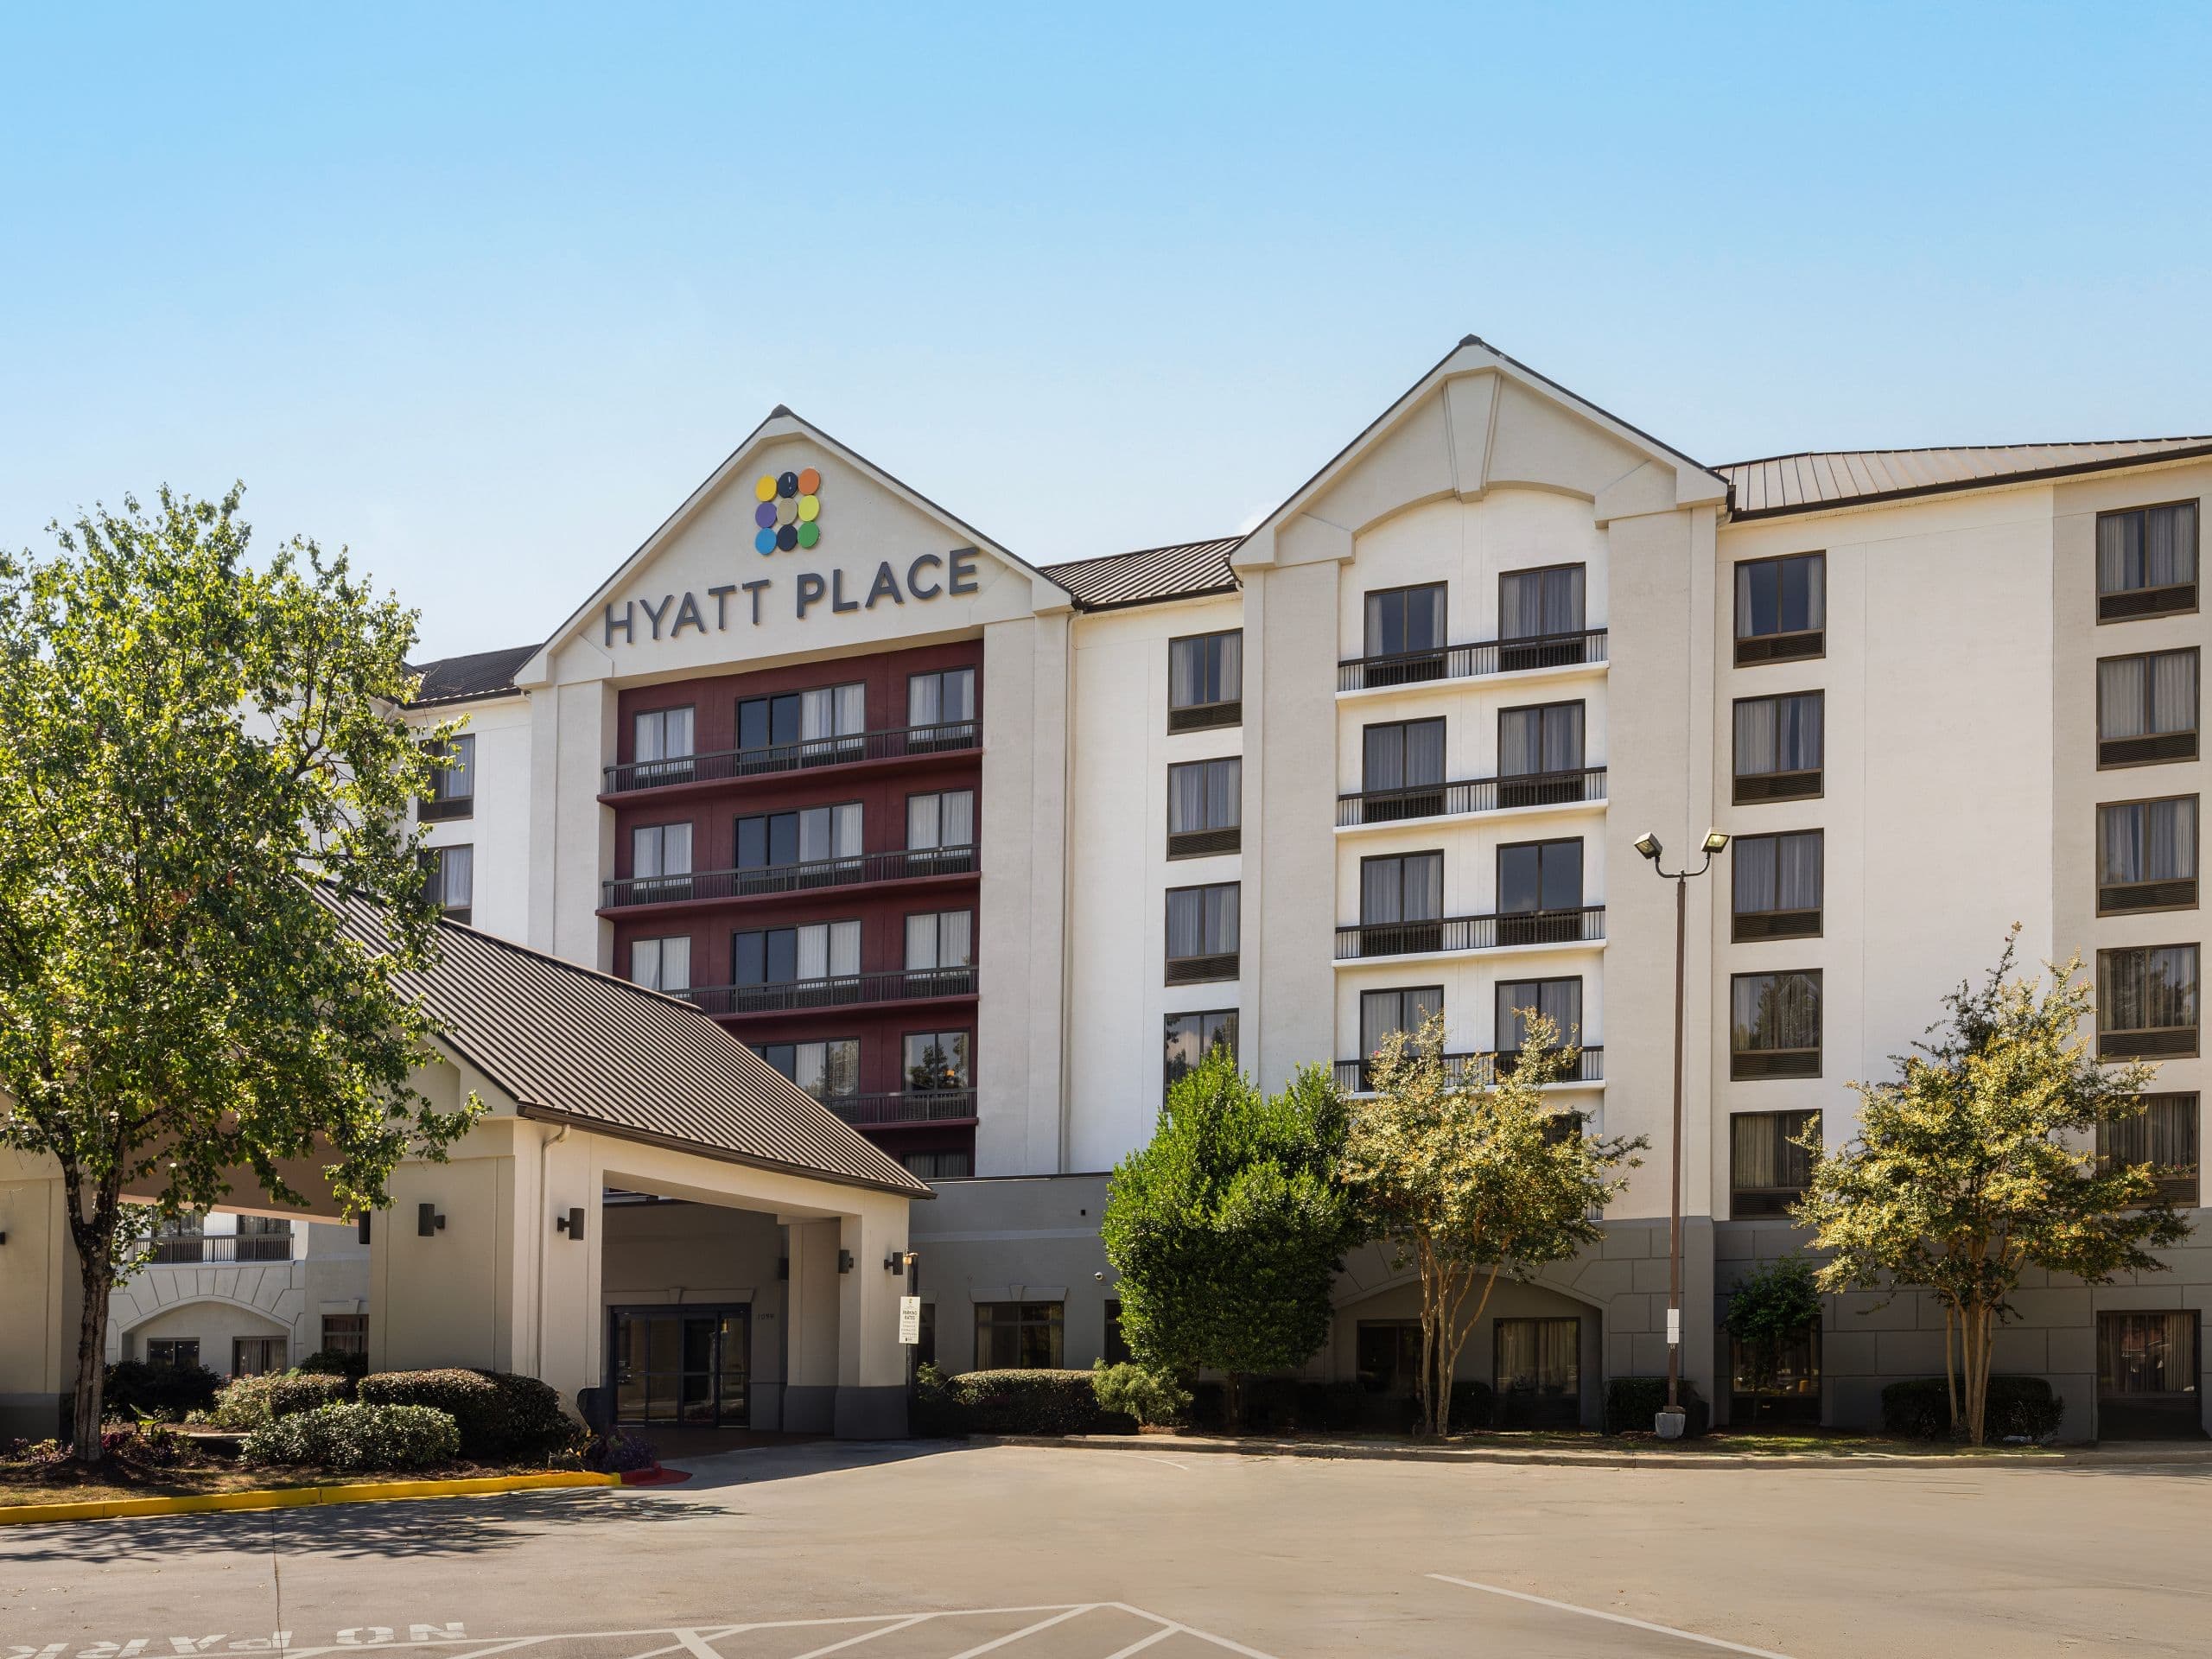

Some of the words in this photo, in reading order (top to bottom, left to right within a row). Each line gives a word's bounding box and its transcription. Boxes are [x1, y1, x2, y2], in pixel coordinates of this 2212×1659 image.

[605, 579, 772, 646] HYATT
[797, 547, 980, 620] PLACE
[336, 1622, 467, 1644] NO
